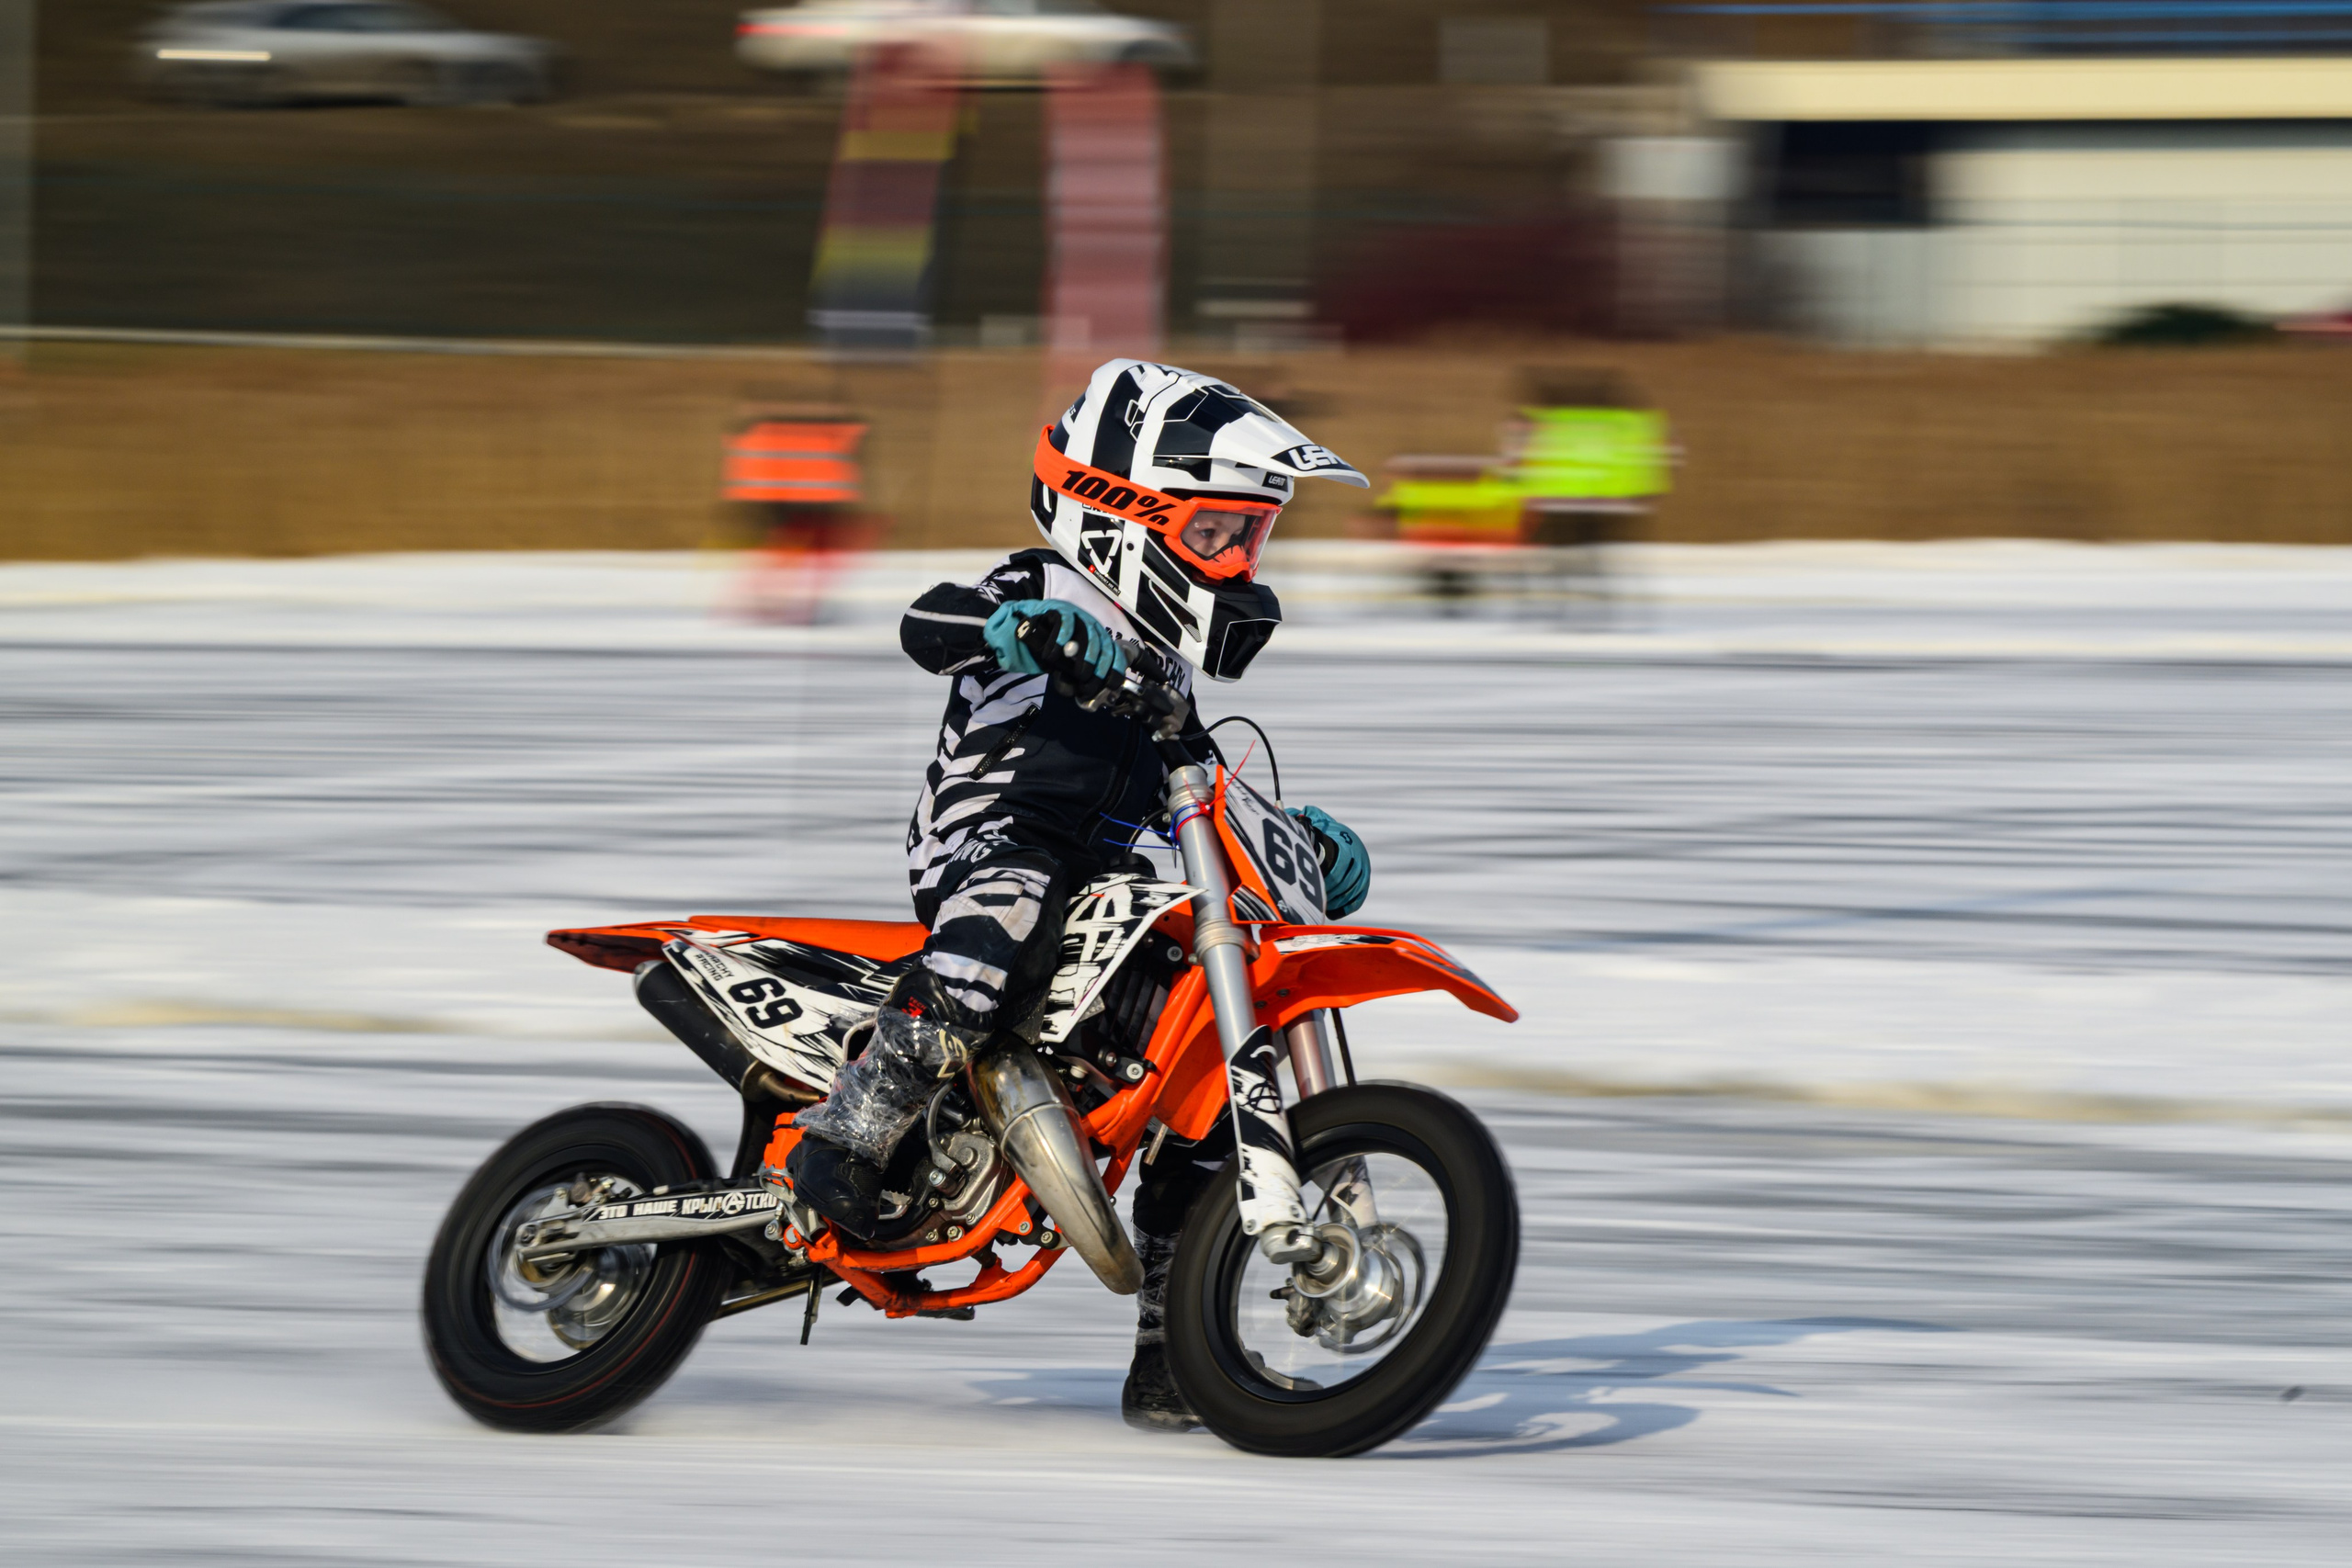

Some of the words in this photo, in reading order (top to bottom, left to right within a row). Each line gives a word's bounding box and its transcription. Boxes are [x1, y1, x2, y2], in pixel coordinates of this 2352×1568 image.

[1061, 469, 1178, 526] 100%
[1261, 818, 1324, 913] 69
[695, 953, 724, 981] RACING
[728, 977, 804, 1029] 69
[598, 1204, 628, 1220] ЭТО
[632, 1200, 678, 1216] НАШЕ
